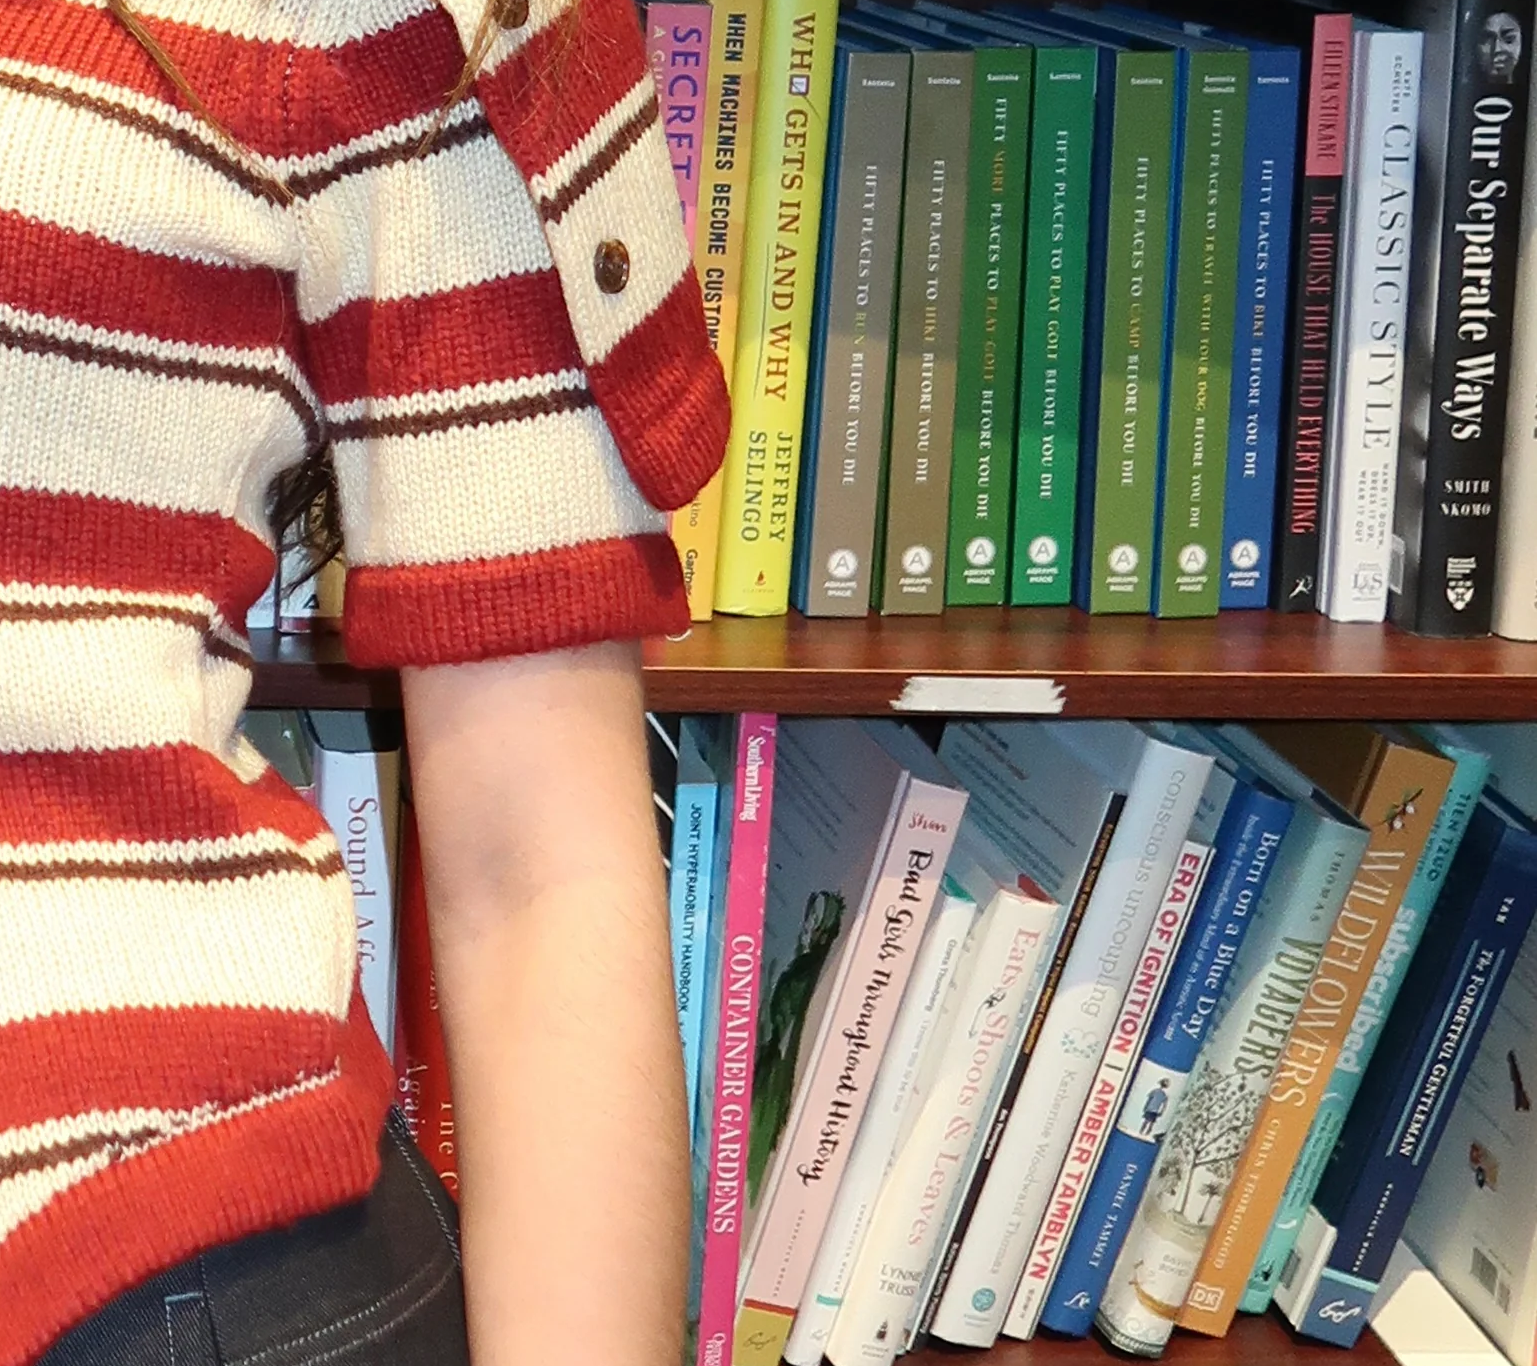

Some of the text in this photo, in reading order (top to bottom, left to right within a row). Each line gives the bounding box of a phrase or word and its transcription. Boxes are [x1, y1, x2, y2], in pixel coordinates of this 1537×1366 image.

[763, 107, 809, 403] GETS IN AND WHY
[1361, 123, 1413, 451] CLASSIC STYLE
[1439, 95, 1513, 442] Our Separate Ways
[1440, 502, 1492, 517] NKOMO
[1443, 480, 1492, 494] SMITH
[712, 934, 756, 1235] CONTAINER GARDENS
[1268, 849, 1406, 1108] WILDFLOWERS
